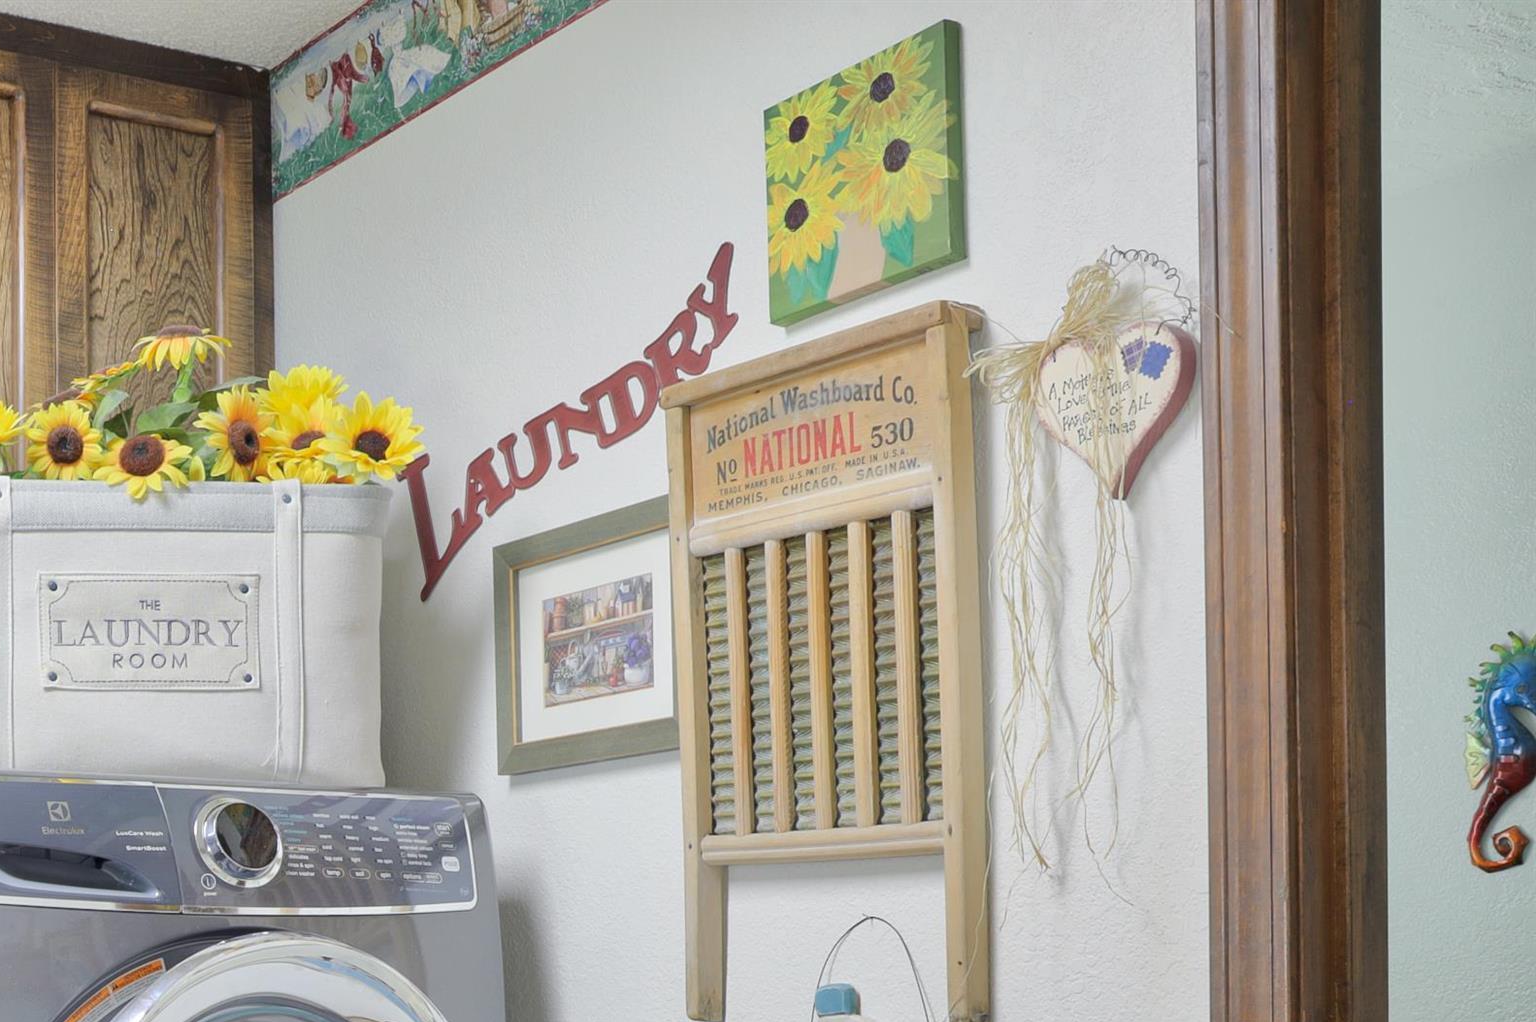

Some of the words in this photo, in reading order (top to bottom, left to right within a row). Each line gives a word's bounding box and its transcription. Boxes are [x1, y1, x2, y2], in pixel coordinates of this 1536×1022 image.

[398, 242, 739, 602] LAUNDRY
[707, 397, 776, 453] National
[780, 375, 884, 415] Washboard
[892, 375, 917, 405] Co.
[743, 411, 862, 478] NATIONAL
[871, 417, 914, 449] 530
[745, 479, 768, 491] MARKS
[845, 456, 866, 468] MADE
[869, 454, 878, 463] IN
[139, 600, 161, 611] THE
[53, 618, 244, 648] LAUNDRY
[113, 652, 188, 669] ROOM
[41, 826, 85, 836] Electrolux
[126, 845, 167, 853] SmartBoost
